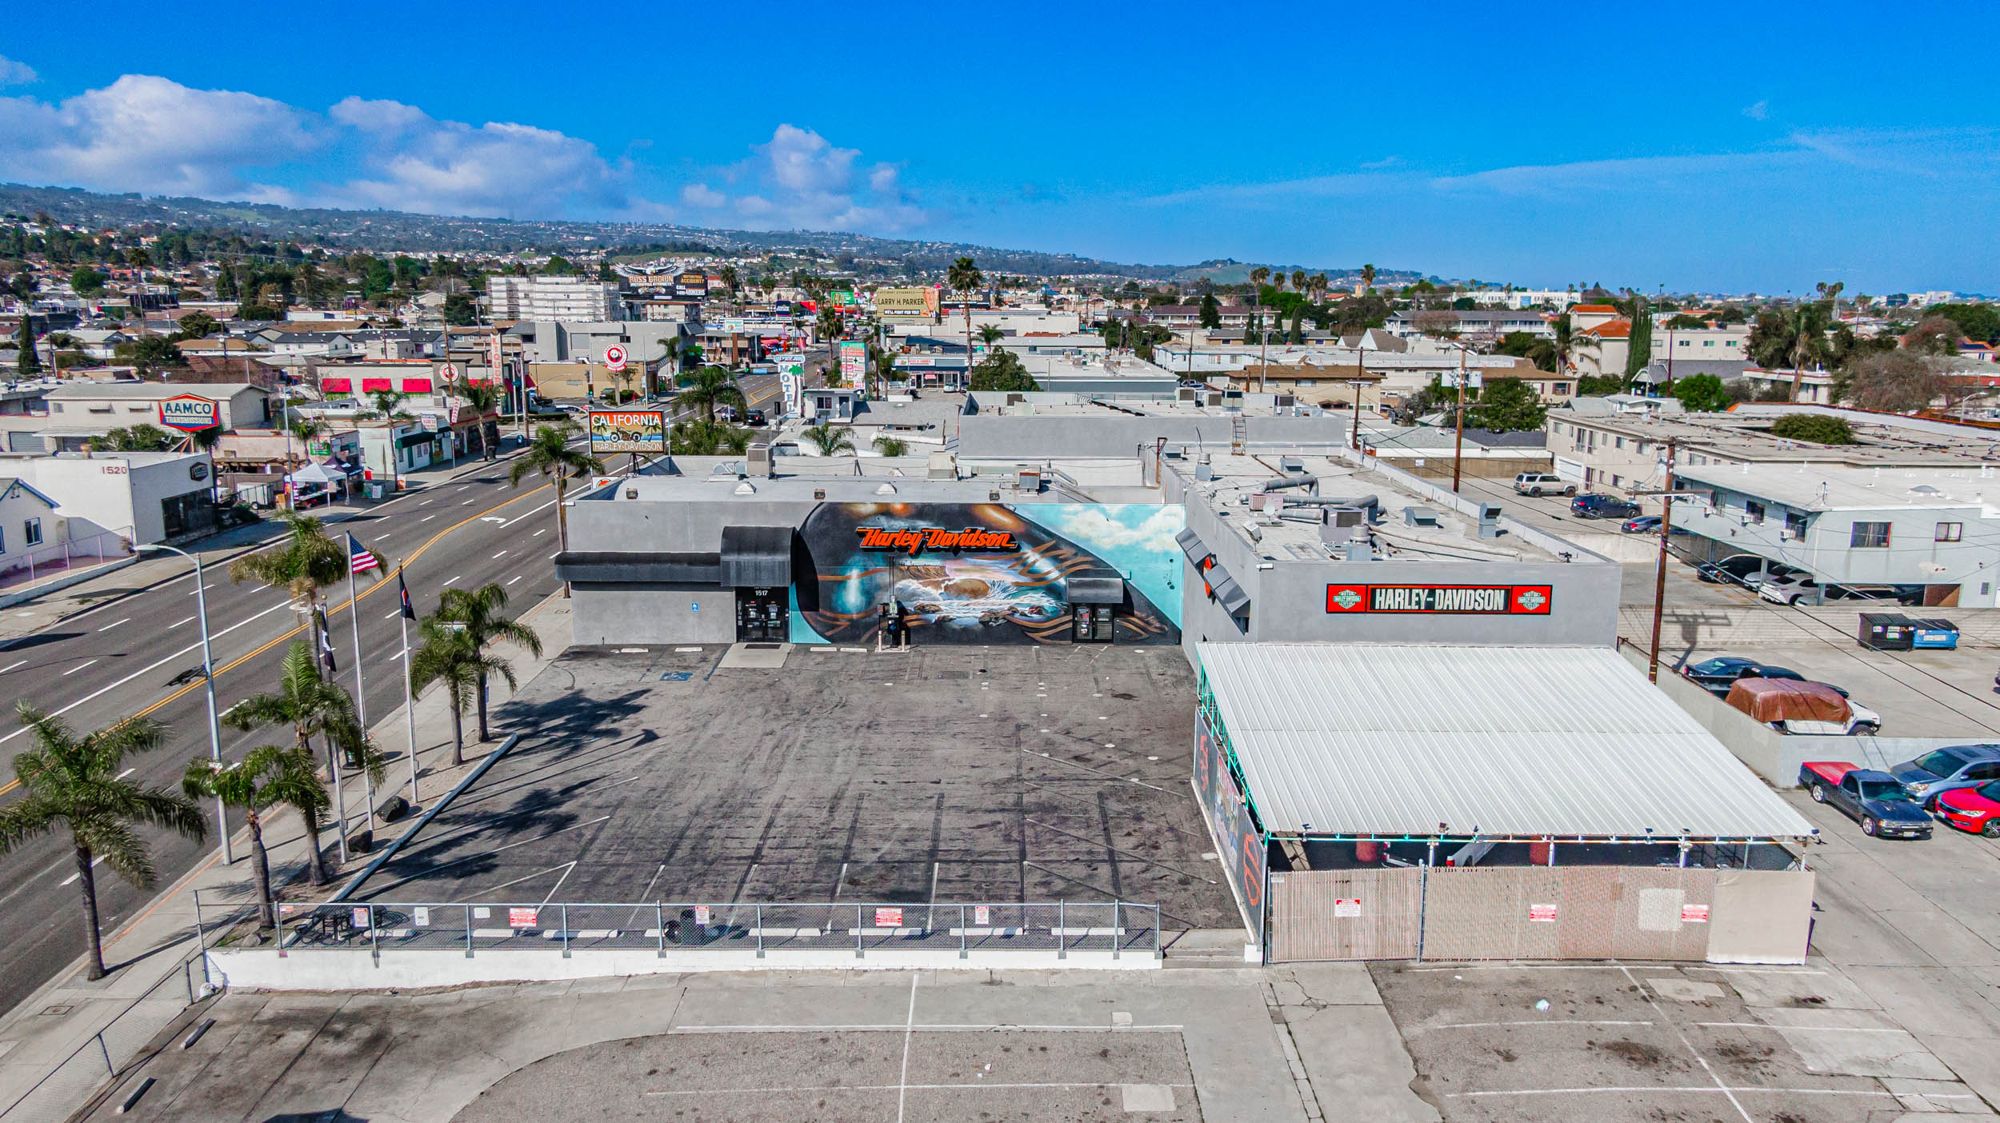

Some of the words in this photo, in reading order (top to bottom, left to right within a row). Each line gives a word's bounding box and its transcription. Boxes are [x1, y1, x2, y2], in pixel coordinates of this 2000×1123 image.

[165, 402, 212, 414] AAMCO
[592, 414, 661, 426] CALIFORNIA
[101, 466, 128, 475] 1520
[856, 527, 1017, 556] Harley-Davidson
[1375, 588, 1504, 610] HARLEY-DAVIDSON
